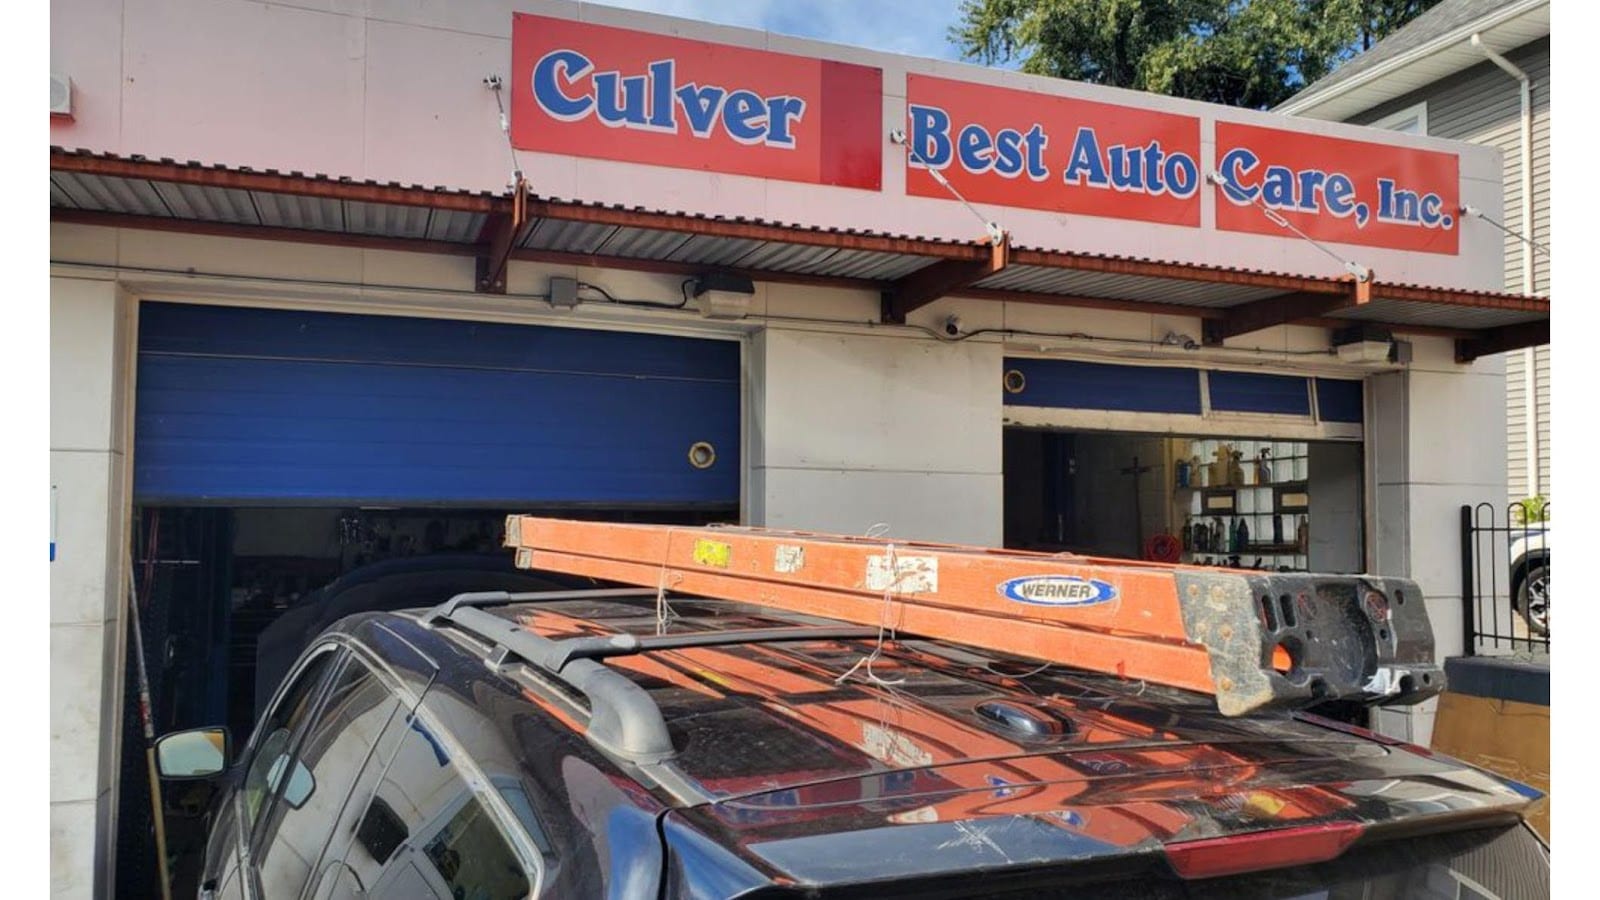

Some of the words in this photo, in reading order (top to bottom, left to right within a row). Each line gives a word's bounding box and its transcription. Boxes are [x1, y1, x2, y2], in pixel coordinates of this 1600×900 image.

[532, 49, 805, 149] Culver
[909, 104, 1049, 181] Best
[1064, 126, 1199, 199] Auto
[1219, 147, 1370, 229] Care,
[1377, 177, 1453, 230] Inc.
[1021, 583, 1092, 599] WERNER
